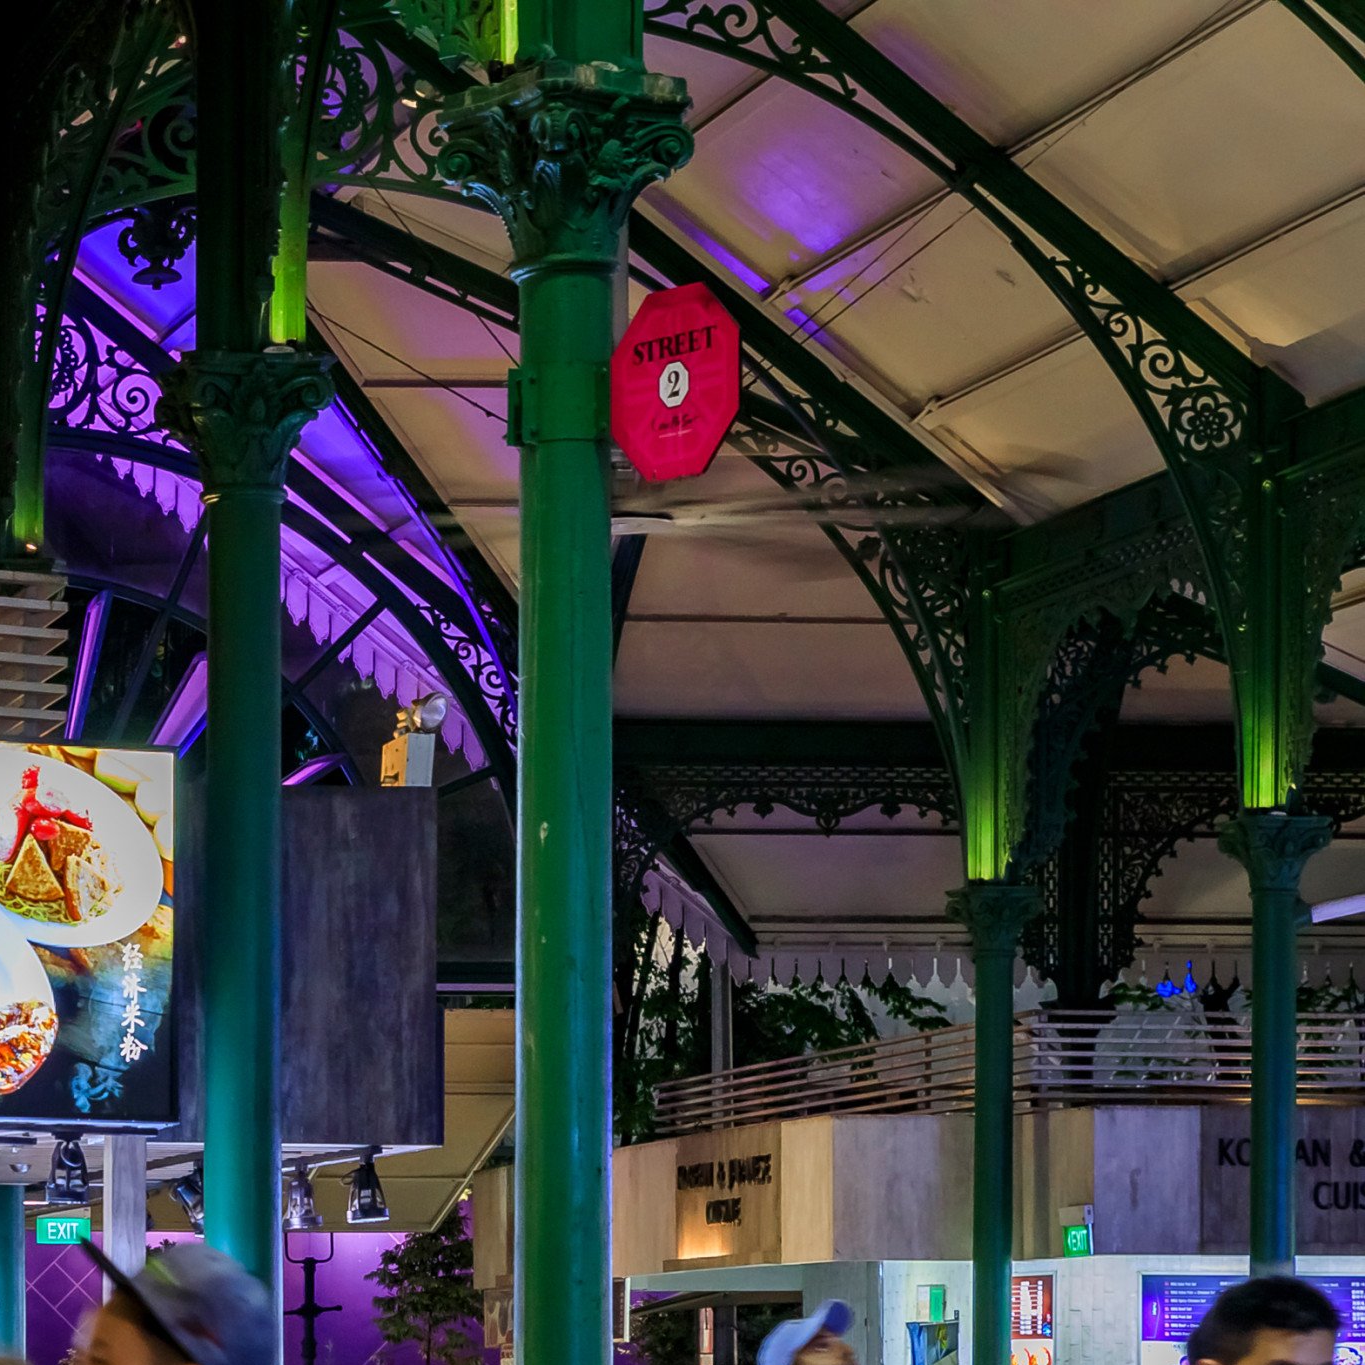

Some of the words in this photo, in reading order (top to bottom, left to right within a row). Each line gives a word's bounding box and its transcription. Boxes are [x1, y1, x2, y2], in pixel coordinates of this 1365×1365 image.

[632, 326, 717, 366] STREET
[667, 370, 680, 399] 2
[1218, 1138, 1331, 1166] KOAN
[47, 1222, 78, 1240] EXIT
[1070, 1230, 1087, 1251] EXIT
